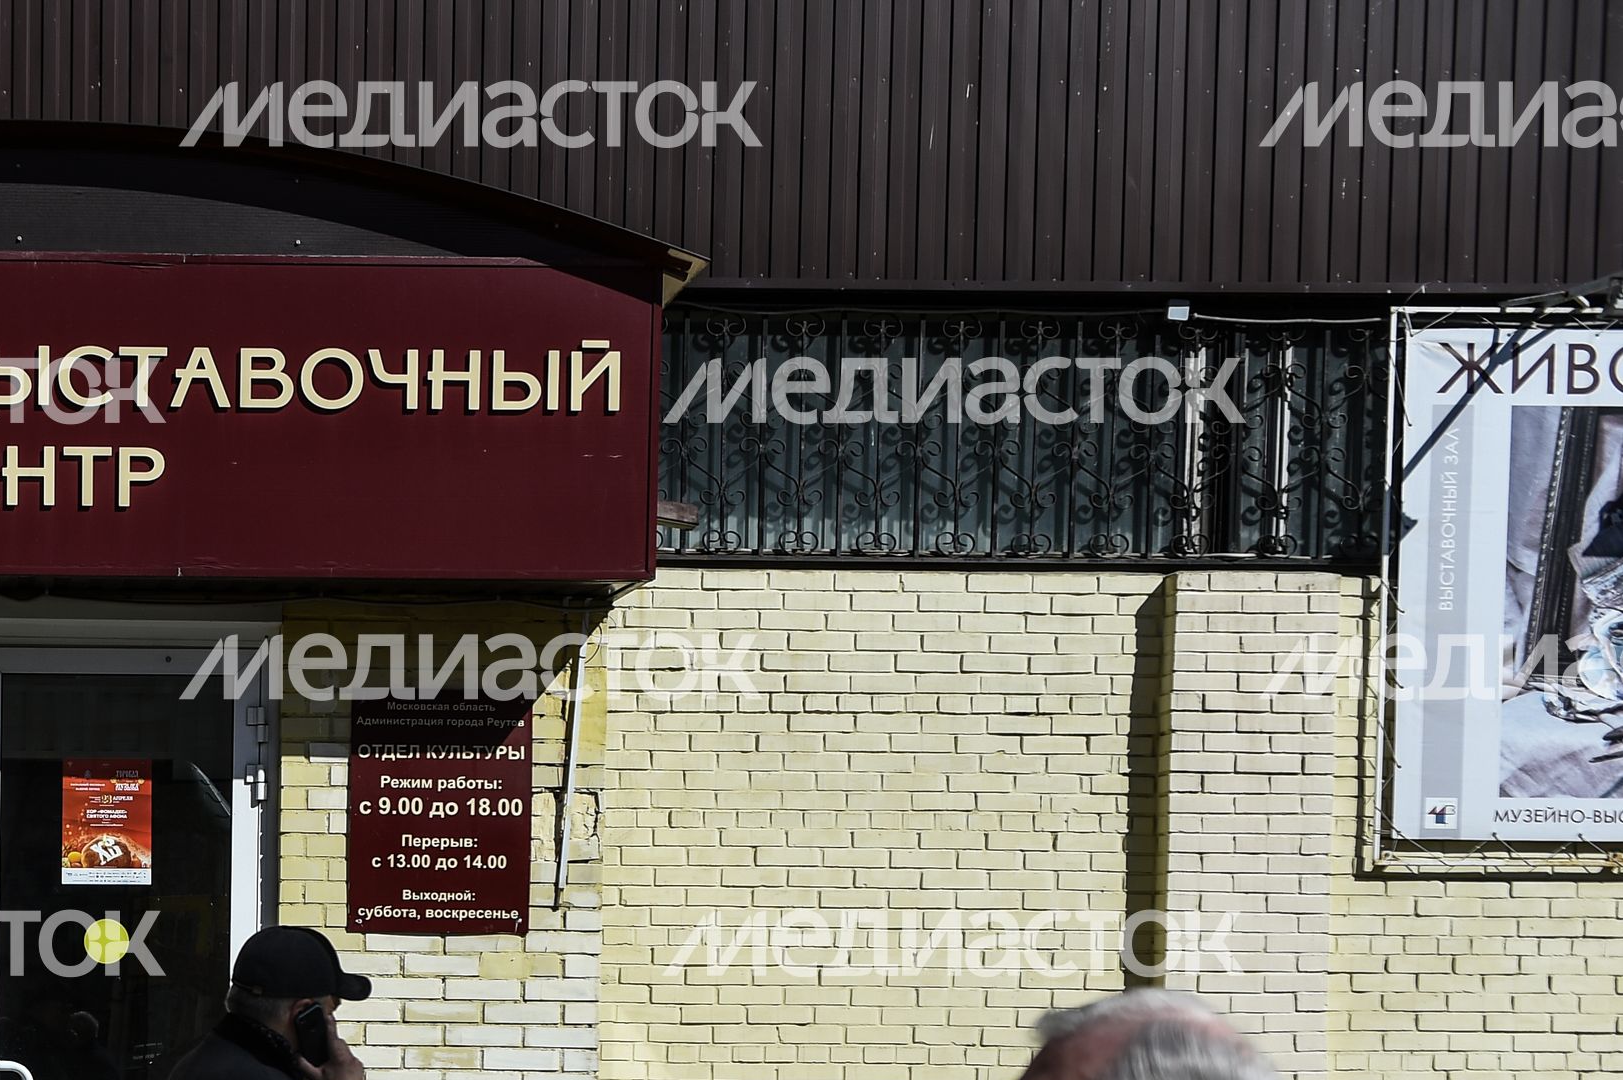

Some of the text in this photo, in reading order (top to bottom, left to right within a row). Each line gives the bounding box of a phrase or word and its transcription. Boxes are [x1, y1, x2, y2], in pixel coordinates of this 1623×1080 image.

[1436, 341, 1623, 395] ЖИВ
[1438, 427, 1460, 612] ВЫСТАВОЧНЫЙ ЗАЛ
[386, 701, 496, 712] Московская область
[356, 716, 525, 728] Администрация города Реутов
[357, 744, 525, 762] ОТДЕЛ КУЛЬТУРЫ
[380, 775, 503, 791] Режим работы:
[359, 797, 523, 818] с 9.00 до 18.00
[401, 834, 478, 849] Перерыв:
[371, 854, 507, 870] с 13.00 до 14.00
[402, 889, 476, 903] Выходной:
[358, 905, 421, 920] суббота,
